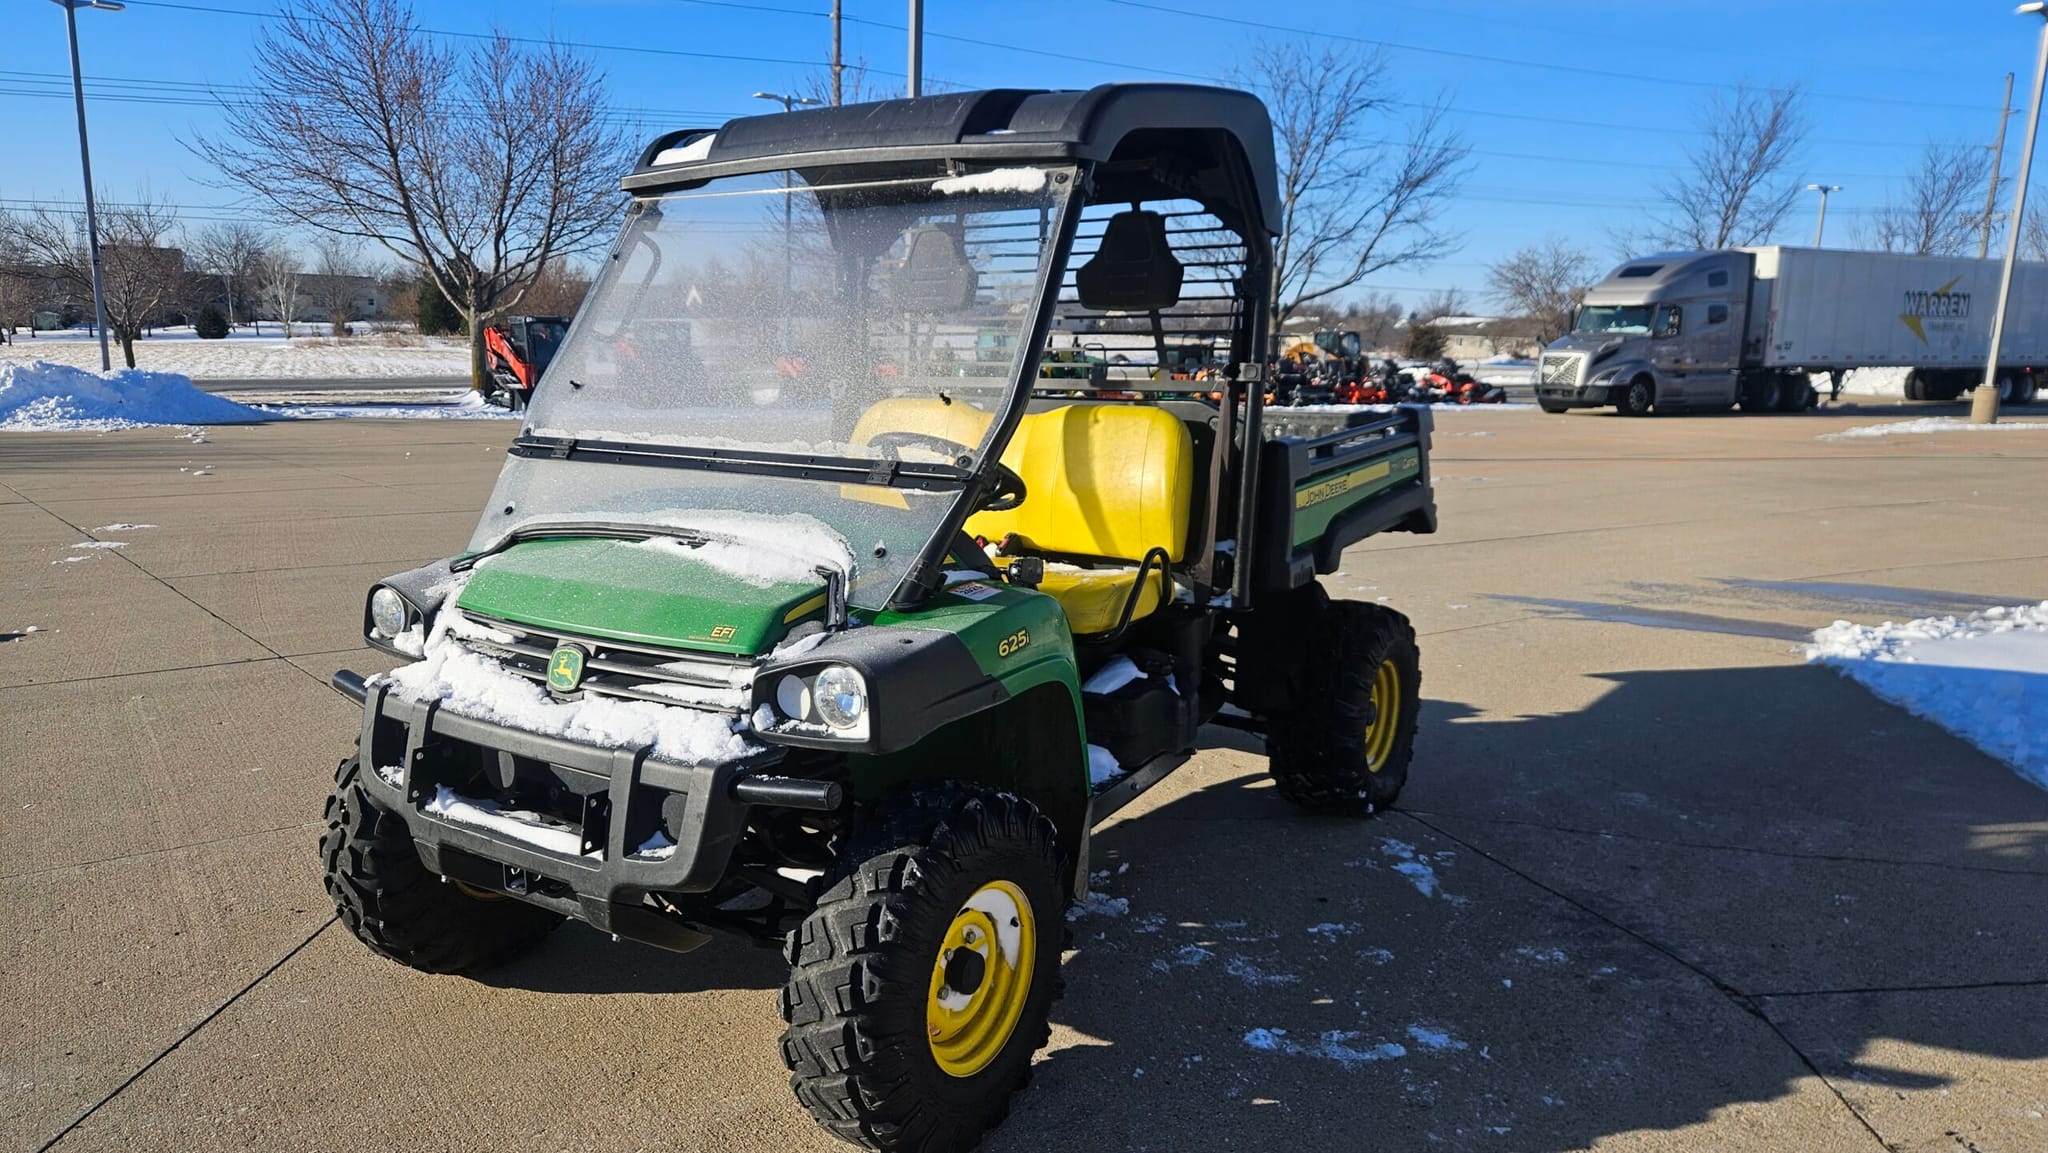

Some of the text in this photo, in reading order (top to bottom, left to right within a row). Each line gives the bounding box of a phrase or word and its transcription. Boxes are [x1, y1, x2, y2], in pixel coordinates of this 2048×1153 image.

[1904, 290, 1971, 318] WARREN
[1305, 479, 1347, 505] JOHN DEERE
[710, 626, 736, 639] EFI
